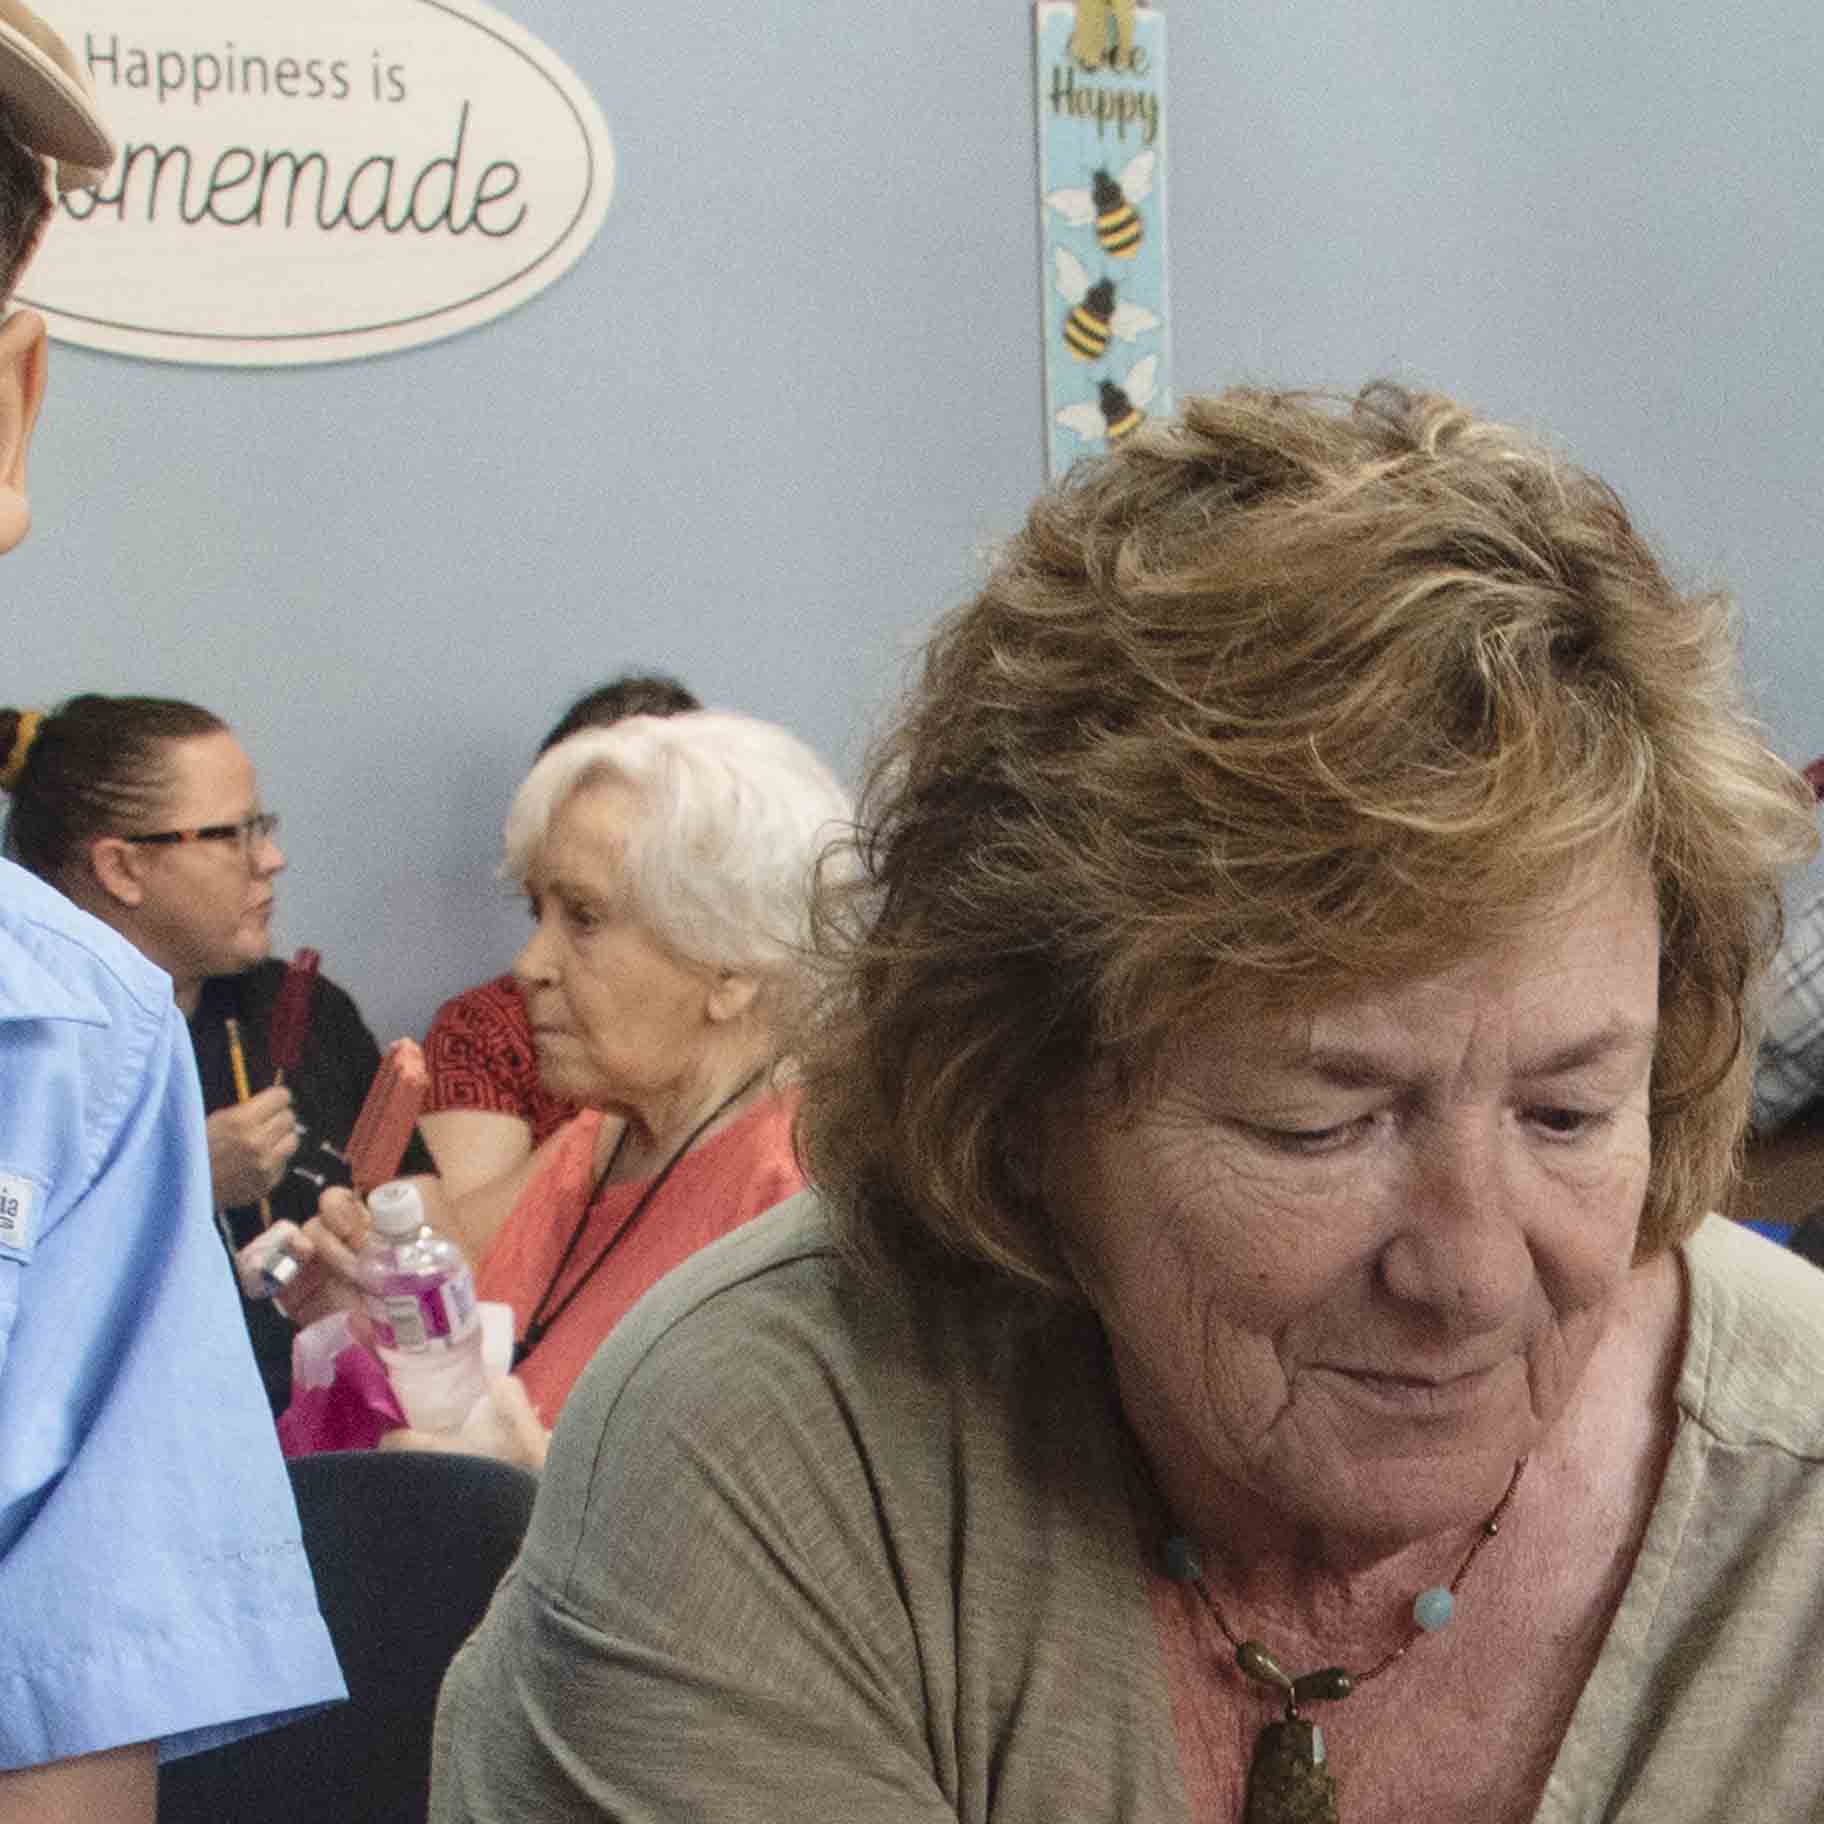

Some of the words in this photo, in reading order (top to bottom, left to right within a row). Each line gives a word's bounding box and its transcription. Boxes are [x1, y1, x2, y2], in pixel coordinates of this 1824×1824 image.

[84, 32, 350, 105] Happiness
[371, 48, 406, 102] is
[1050, 64, 1160, 145] Happy
